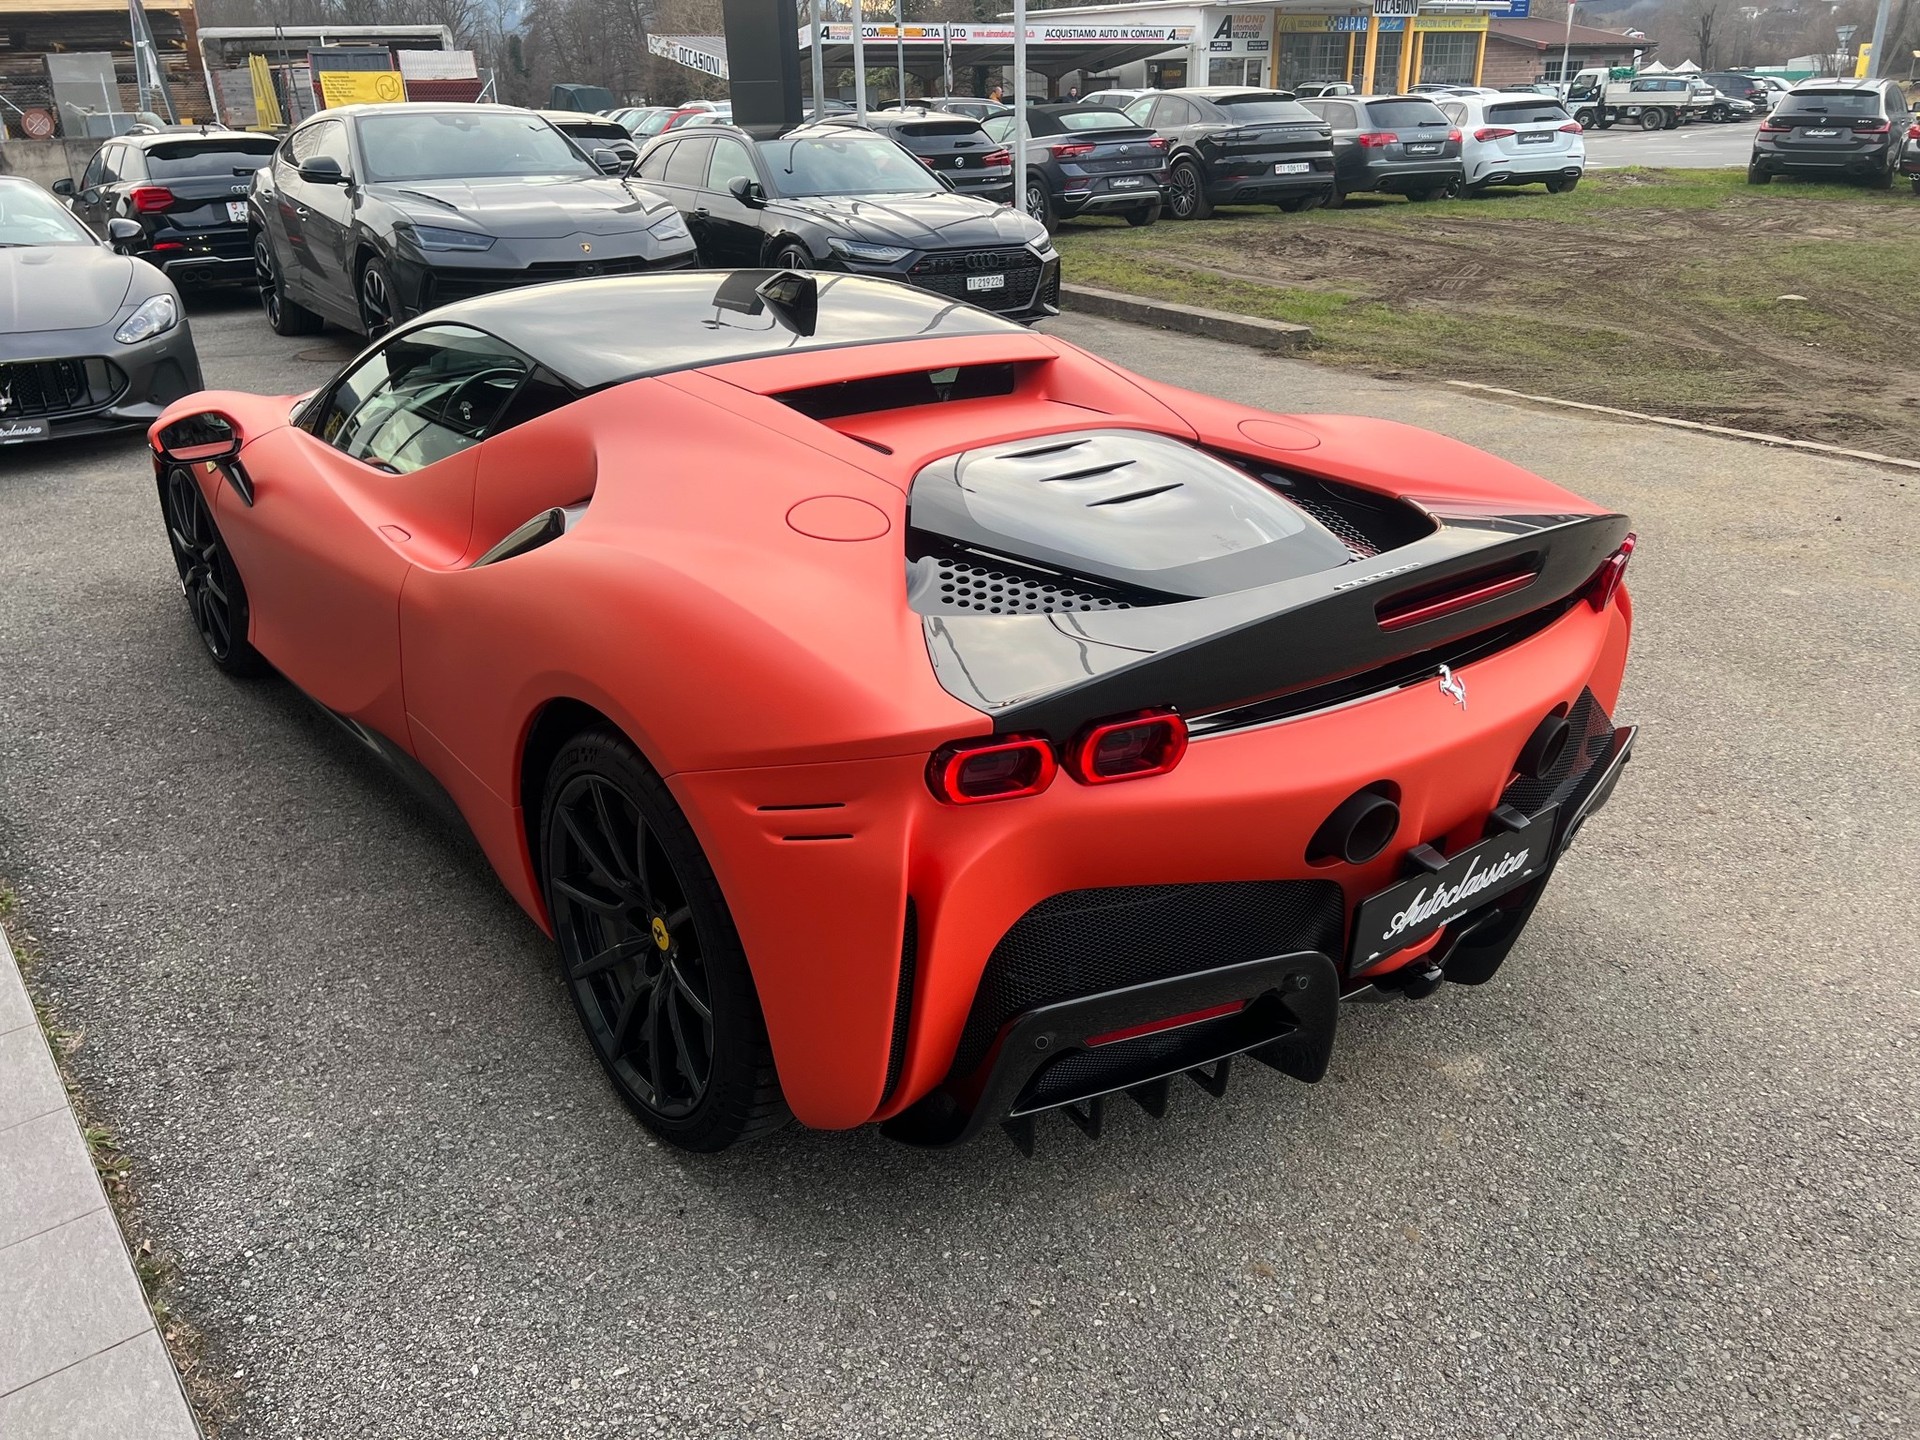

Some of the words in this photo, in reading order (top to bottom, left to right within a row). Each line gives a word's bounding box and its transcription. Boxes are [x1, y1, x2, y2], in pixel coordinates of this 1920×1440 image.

[1045, 28, 1097, 39] ACQUISTIAMO
[1099, 29, 1119, 38] AUTO
[1120, 29, 1129, 38] IN
[1130, 29, 1165, 38] CONTANTI
[1338, 15, 1369, 31] GARAG
[679, 47, 720, 75] OCCASIONI
[1382, 848, 1530, 940] Autoclassica
